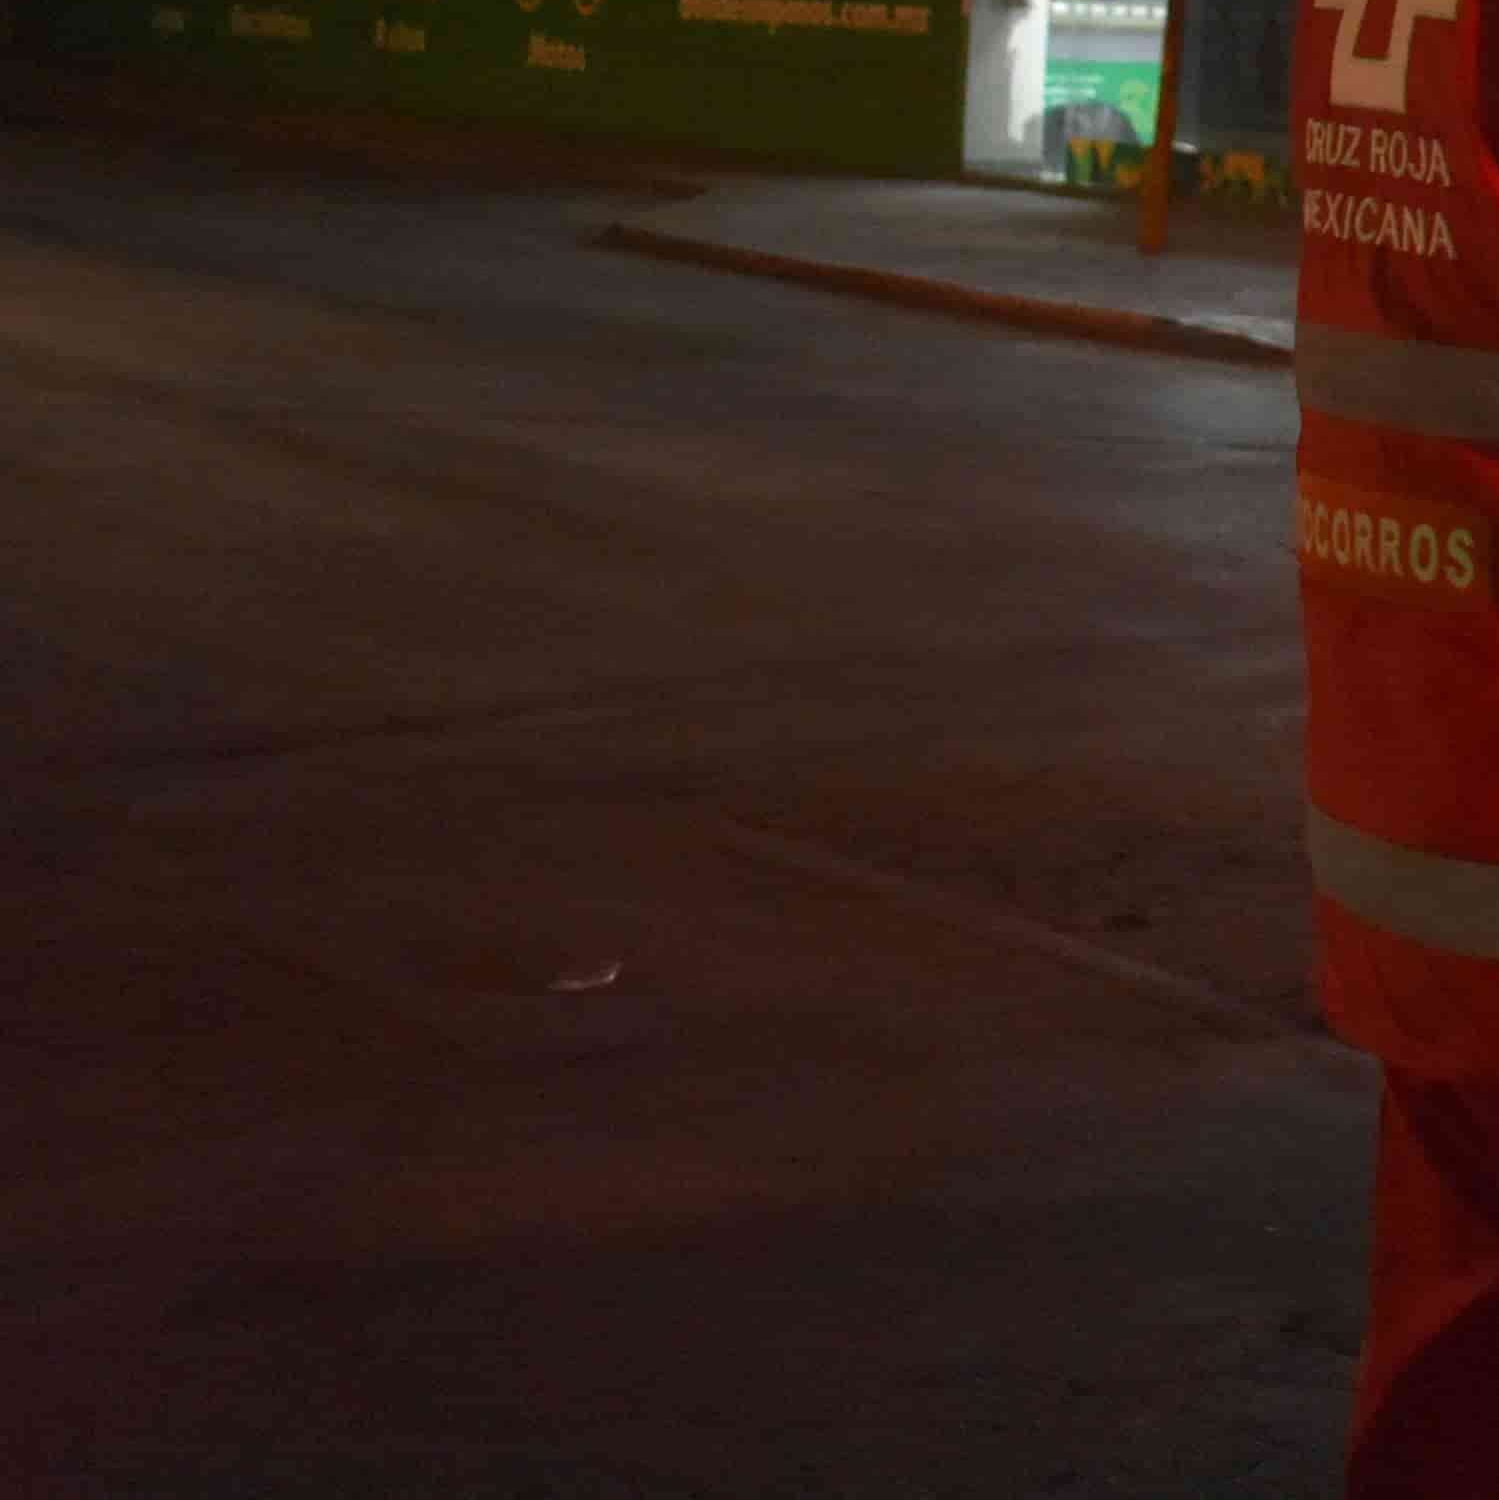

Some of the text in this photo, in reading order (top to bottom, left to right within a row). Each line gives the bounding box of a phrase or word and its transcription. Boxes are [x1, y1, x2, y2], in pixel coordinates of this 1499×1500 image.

[1369, 125, 1454, 188] ROJA
[1304, 188, 1460, 261] EXICANA
[1300, 498, 1476, 588] OCORROS
